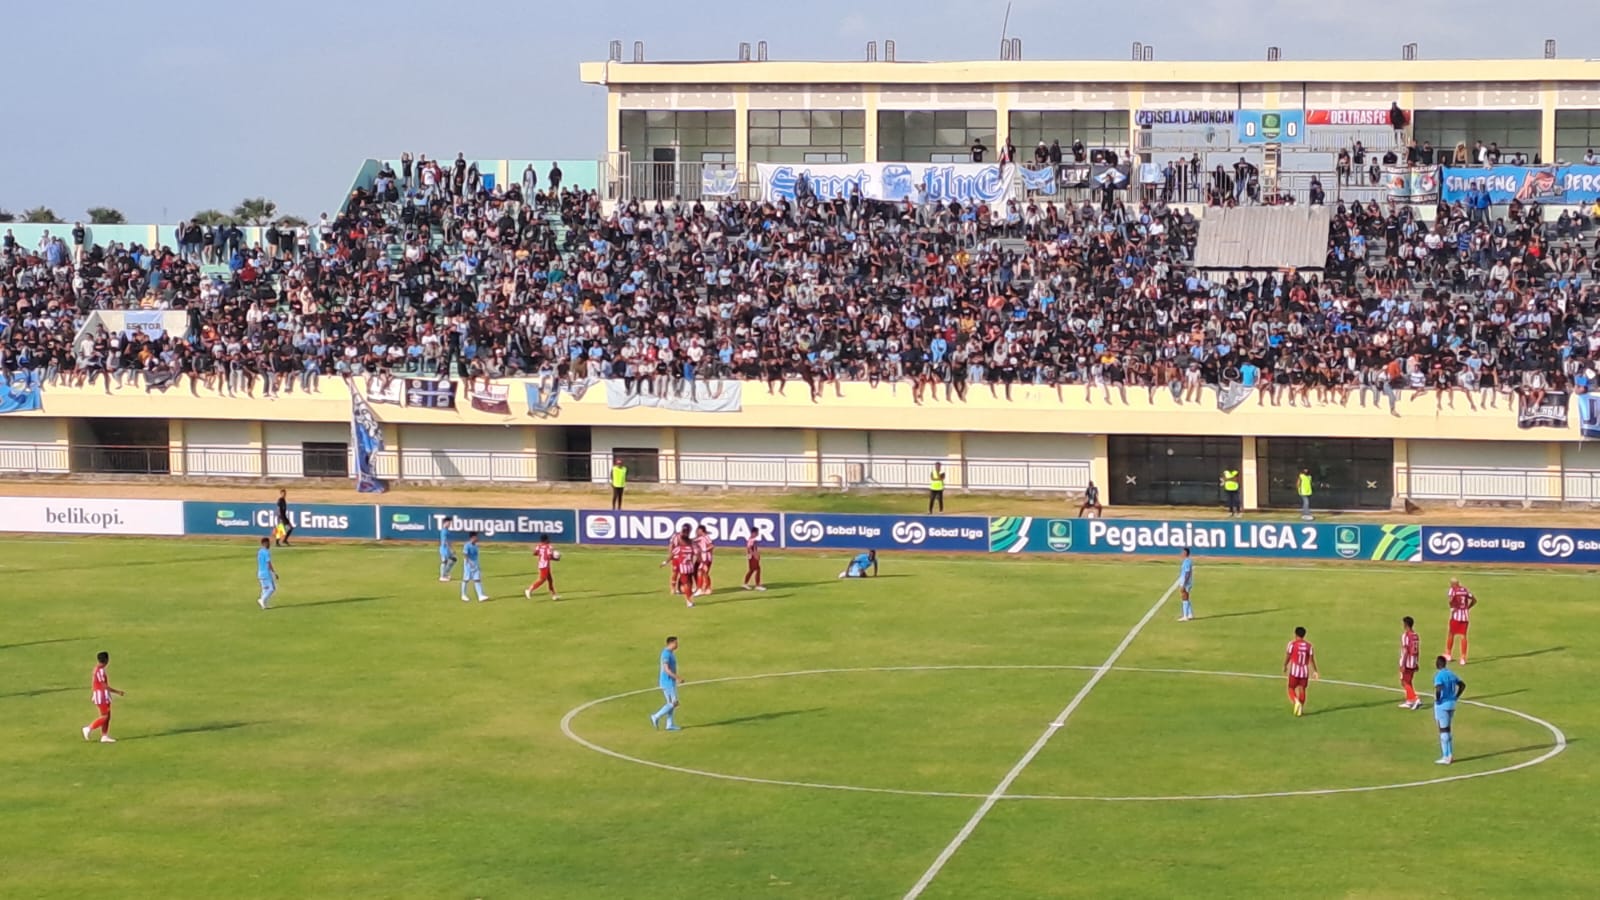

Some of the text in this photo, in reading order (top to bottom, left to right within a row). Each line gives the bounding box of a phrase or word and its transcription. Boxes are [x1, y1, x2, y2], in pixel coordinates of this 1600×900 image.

[1139, 110, 1234, 124] PERSELA LAMONGAN
[1245, 122, 1255, 137] 0
[1287, 122, 1297, 137] 0
[46, 506, 124, 529] belikopi.
[301, 511, 348, 530] Emas
[433, 514, 564, 537] Tbungan Emas
[620, 515, 775, 542] INDOSIAR
[826, 525, 880, 538] Sobat Liga
[928, 527, 983, 540] Sobat Liga
[1089, 521, 1226, 552] Pegadaian
[1234, 525, 1297, 549] LIGA
[1301, 527, 1318, 549] 2
[1467, 538, 1525, 551] Sobat Liga
